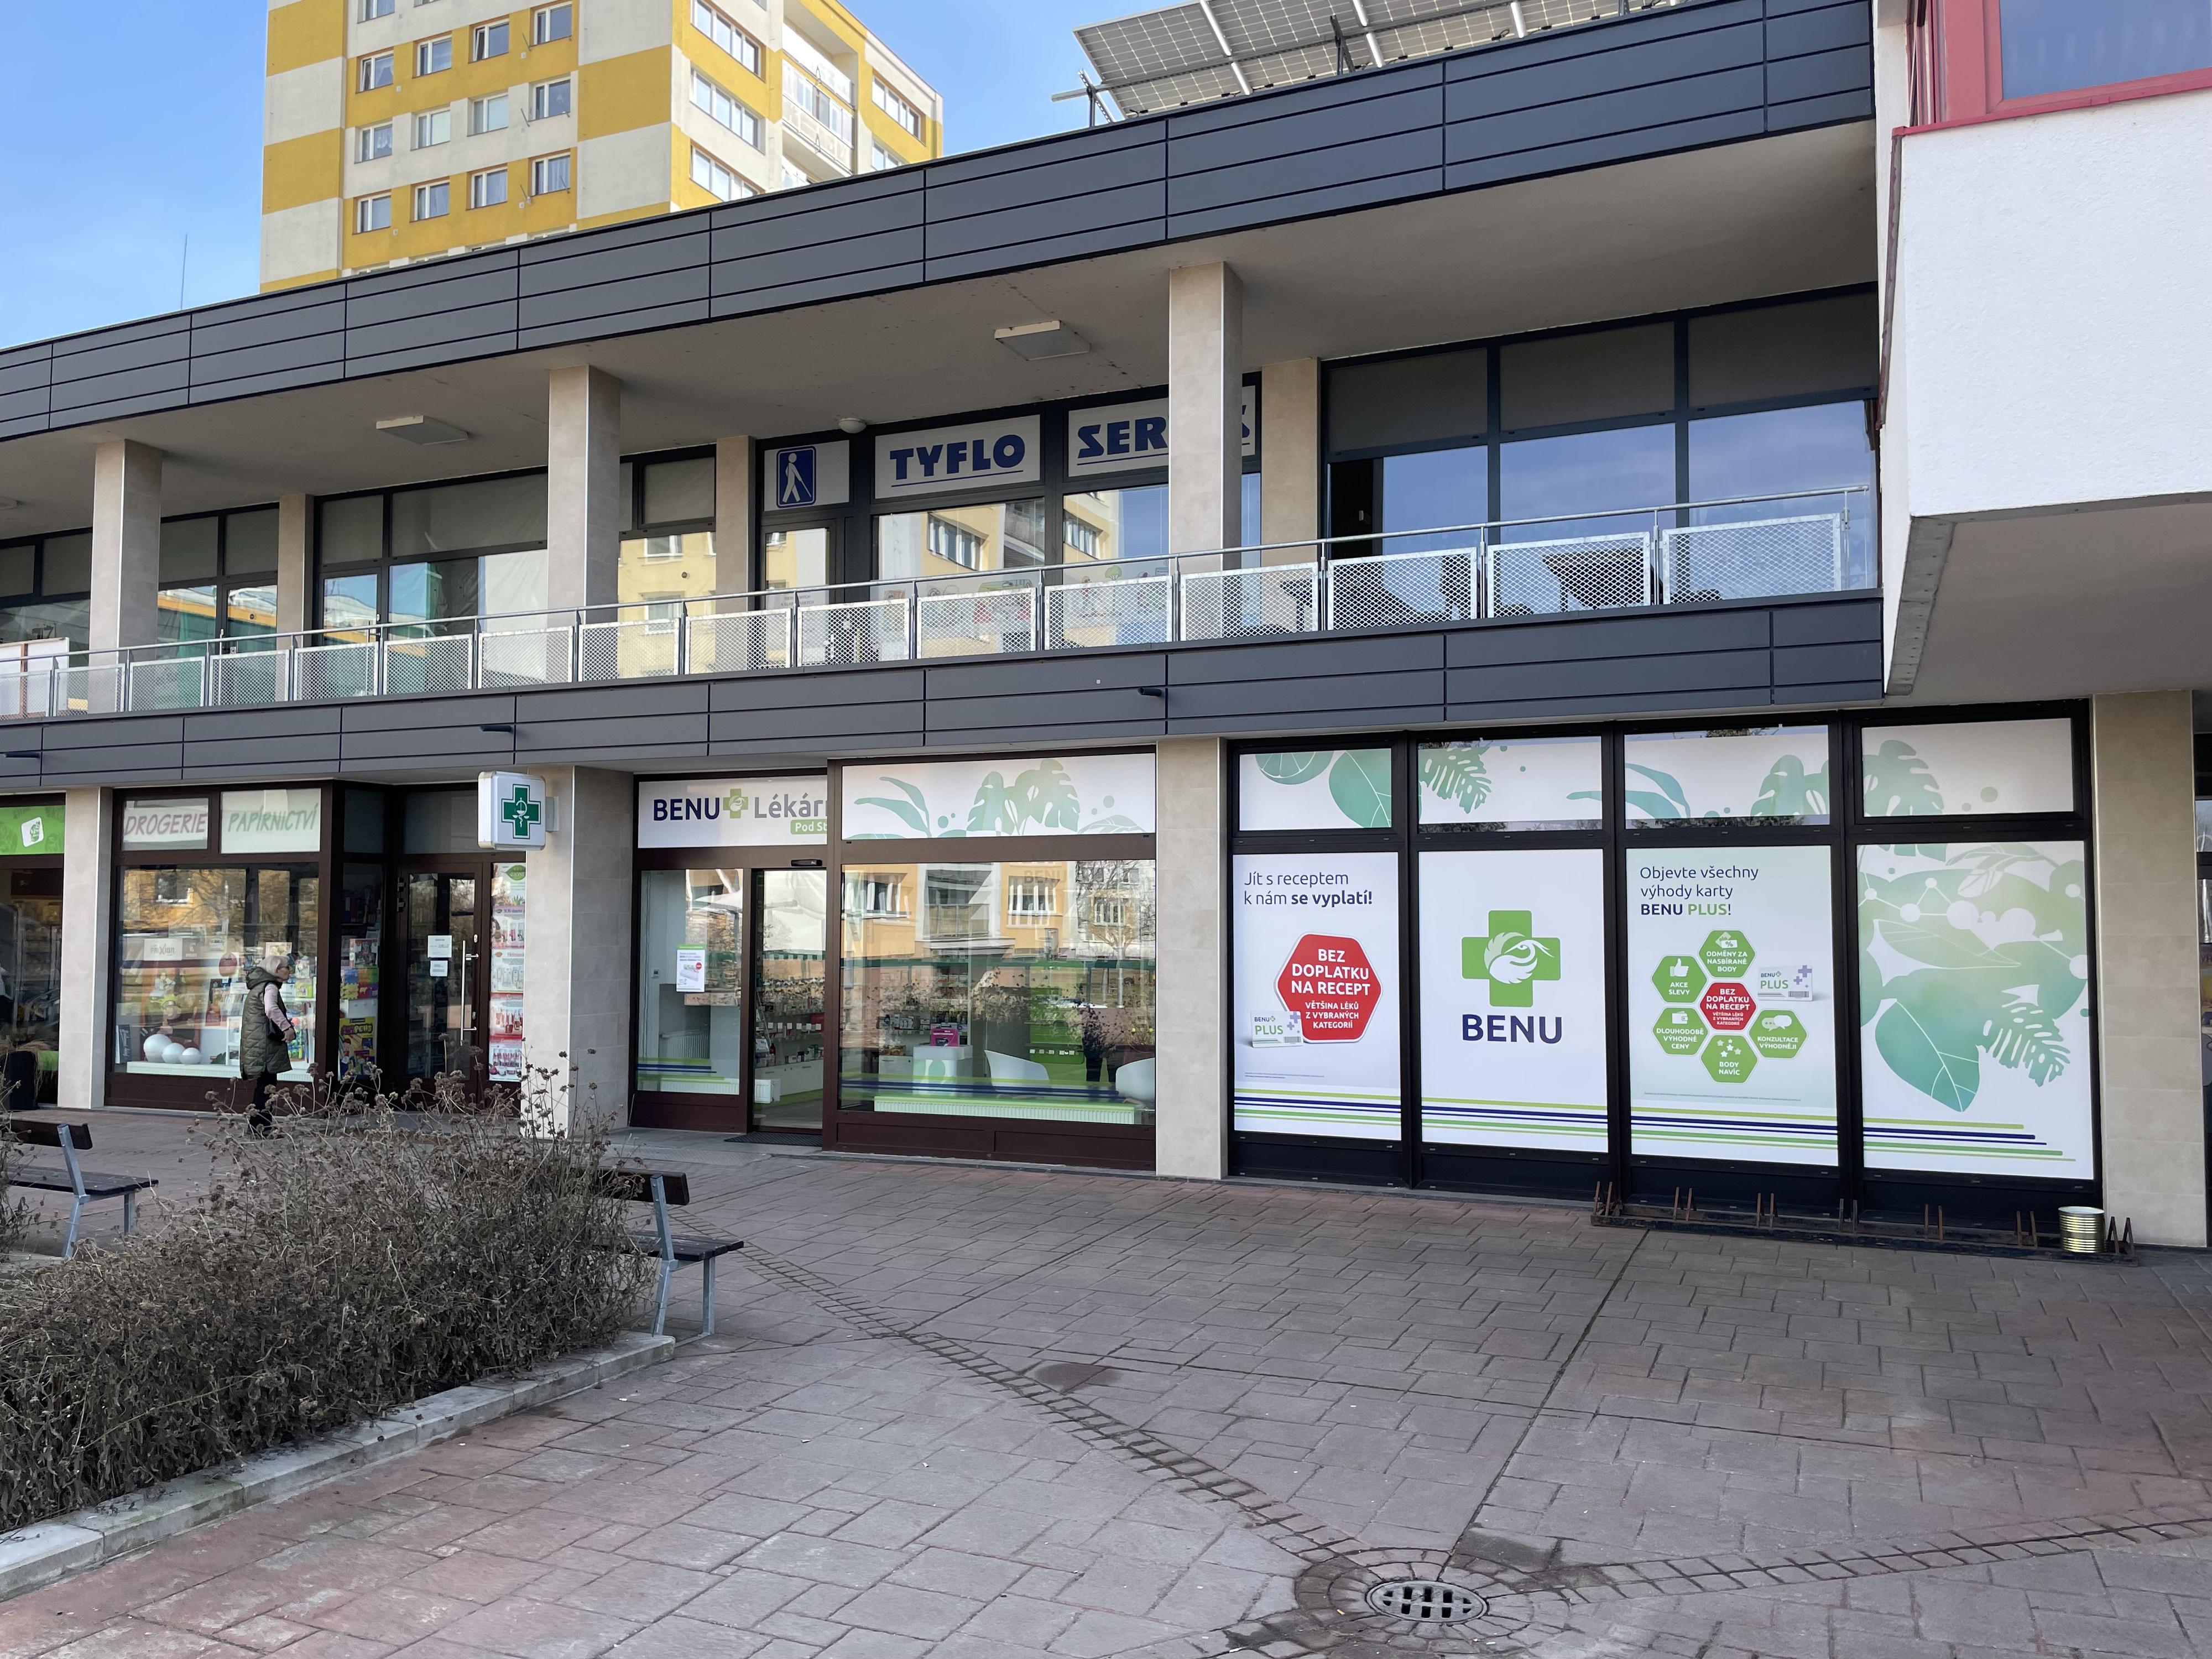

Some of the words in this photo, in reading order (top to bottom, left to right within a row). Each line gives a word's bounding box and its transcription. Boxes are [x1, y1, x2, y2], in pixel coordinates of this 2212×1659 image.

[889, 434, 1025, 481] TYFLO
[653, 797, 720, 821] BENU
[754, 792, 828, 818] Lékár
[124, 813, 207, 836] DROGERIE
[795, 821, 815, 832] Pod
[1244, 871, 1263, 885] Jít
[1266, 875, 1274, 885] s
[1277, 872, 1349, 888] receptem
[1640, 866, 1697, 881] Objevte
[1700, 865, 1759, 881] všechny
[1244, 890, 1252, 905] k
[1256, 890, 1287, 905] nám
[1291, 894, 1308, 905] se
[1312, 889, 1373, 907] vyplatí!
[1640, 884, 1692, 900] výhody
[1696, 884, 1733, 900] karty
[1641, 904, 1683, 915] BENU
[1688, 903, 1731, 916] PLUS!
[1318, 948, 1345, 963] BEZ
[1292, 963, 1369, 980] DOPLATKU
[1291, 980, 1314, 994] NA
[1317, 981, 1371, 996] RECEPT
[1760, 980, 1789, 989] PLUS
[1305, 1000, 1339, 1010] VĚTŠINA
[1340, 1001, 1359, 1010] LÉKŮ
[1312, 1010, 1359, 1019] VYBRANÝCH
[1255, 1025, 1284, 1035] PLUS
[1313, 1020, 1353, 1029] KATEGORIÍ
[1462, 1014, 1563, 1044] BENU
